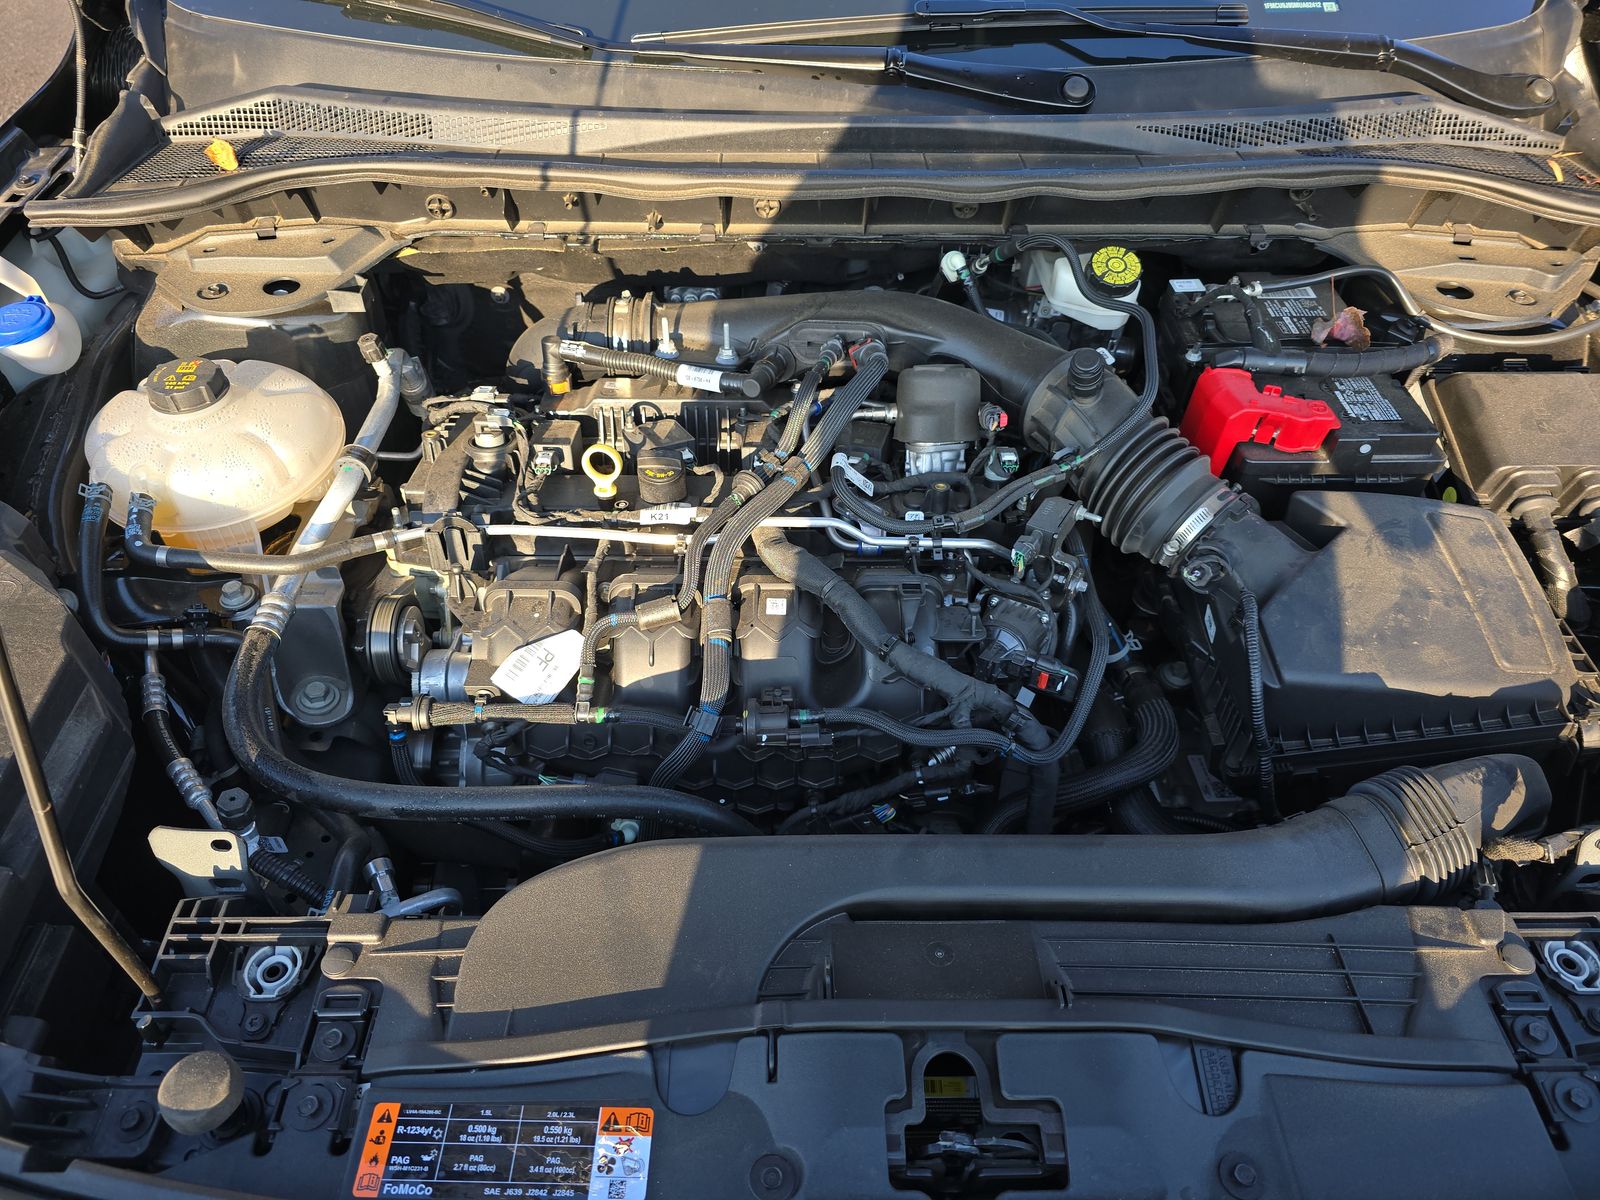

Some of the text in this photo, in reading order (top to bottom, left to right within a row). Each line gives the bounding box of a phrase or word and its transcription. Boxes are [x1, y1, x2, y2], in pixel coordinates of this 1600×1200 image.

[650, 513, 669, 521] K21
[536, 647, 556, 673] PF
[396, 1125, 433, 1136] R-1234yf
[467, 1124, 497, 1135] 0.500 kg
[543, 1126, 573, 1136] 0.550 kg
[490, 1134, 503, 1143] lbs)
[554, 1136, 569, 1144] (1.21
[569, 1136, 581, 1144] lbs)
[390, 1155, 410, 1164] PAG
[469, 1154, 484, 1162] PAG
[453, 1163, 464, 1171] 2.7
[528, 1165, 539, 1173] 3.4
[382, 1183, 433, 1195] FoMoCo
[484, 1187, 575, 1197] SAE J639 J2842 J2845
